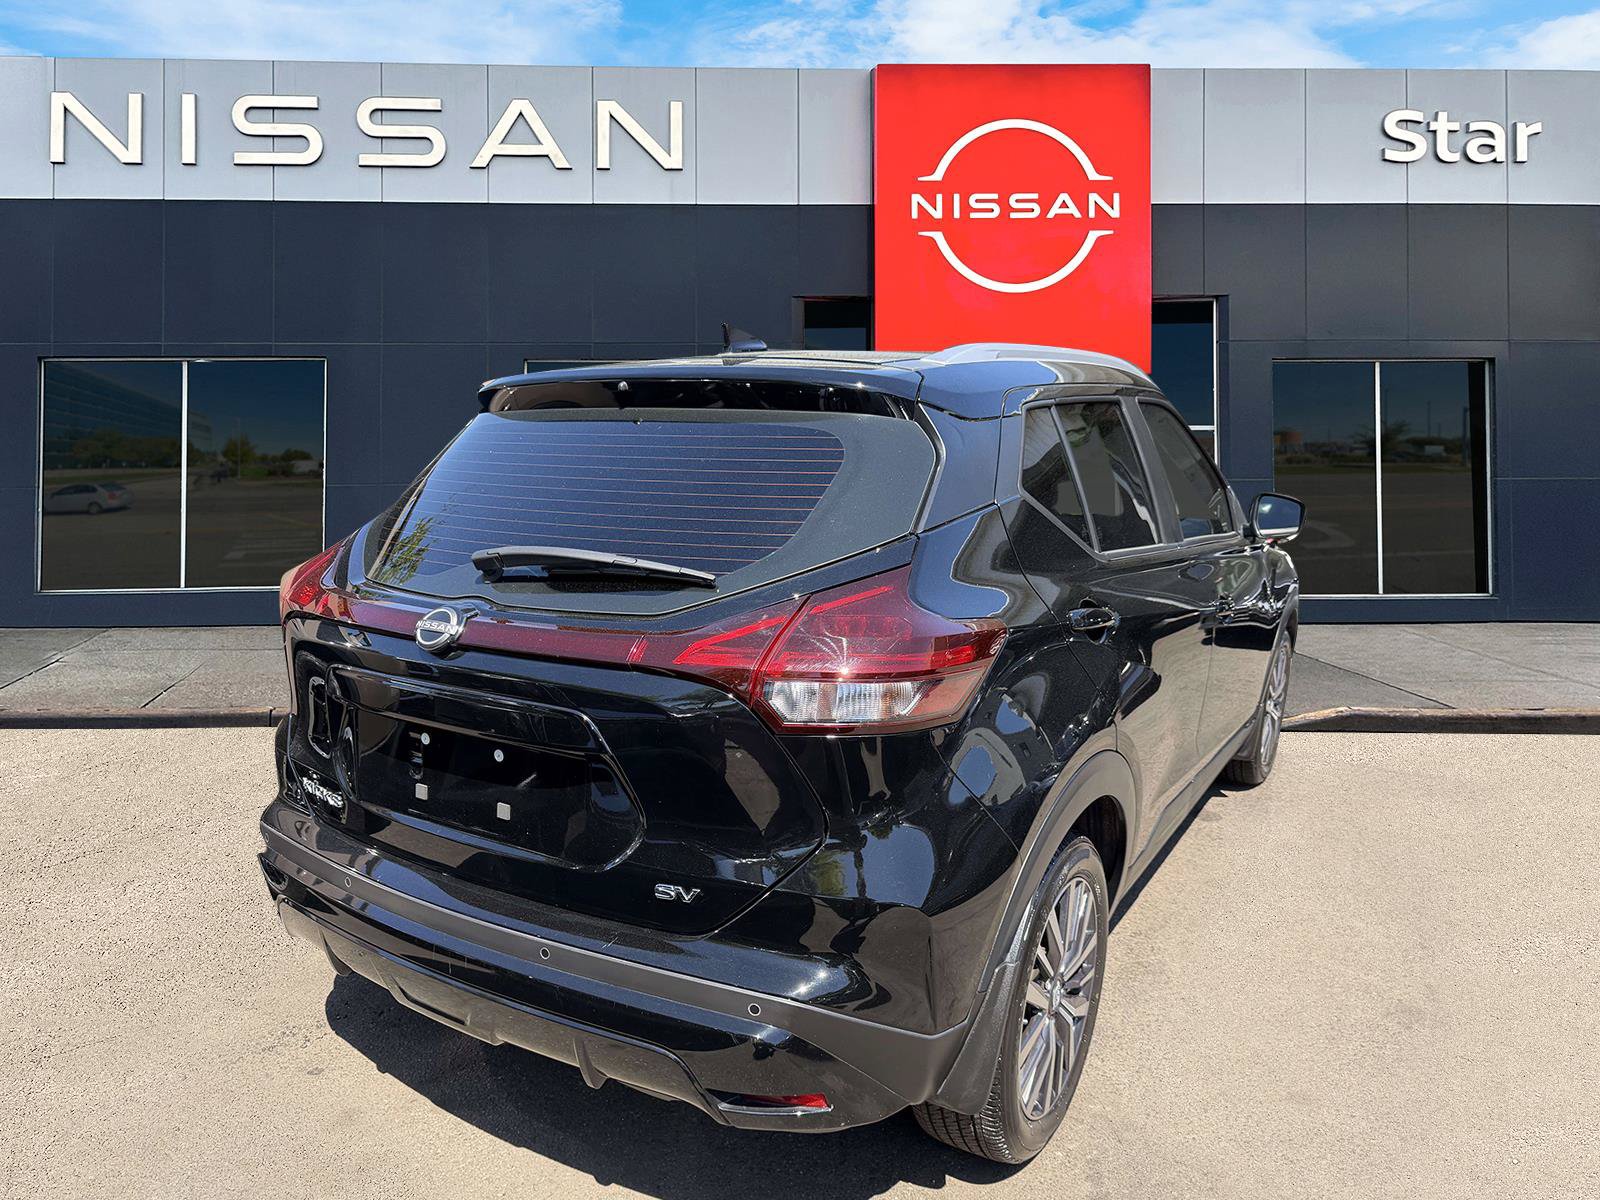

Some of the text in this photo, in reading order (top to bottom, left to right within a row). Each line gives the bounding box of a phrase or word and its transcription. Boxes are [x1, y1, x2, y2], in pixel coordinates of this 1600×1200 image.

[50, 91, 683, 170] NISSAN
[1381, 108, 1542, 164] Star
[911, 192, 1120, 219] NISSAN
[416, 620, 459, 635] NISSAN
[654, 883, 700, 903] SV
